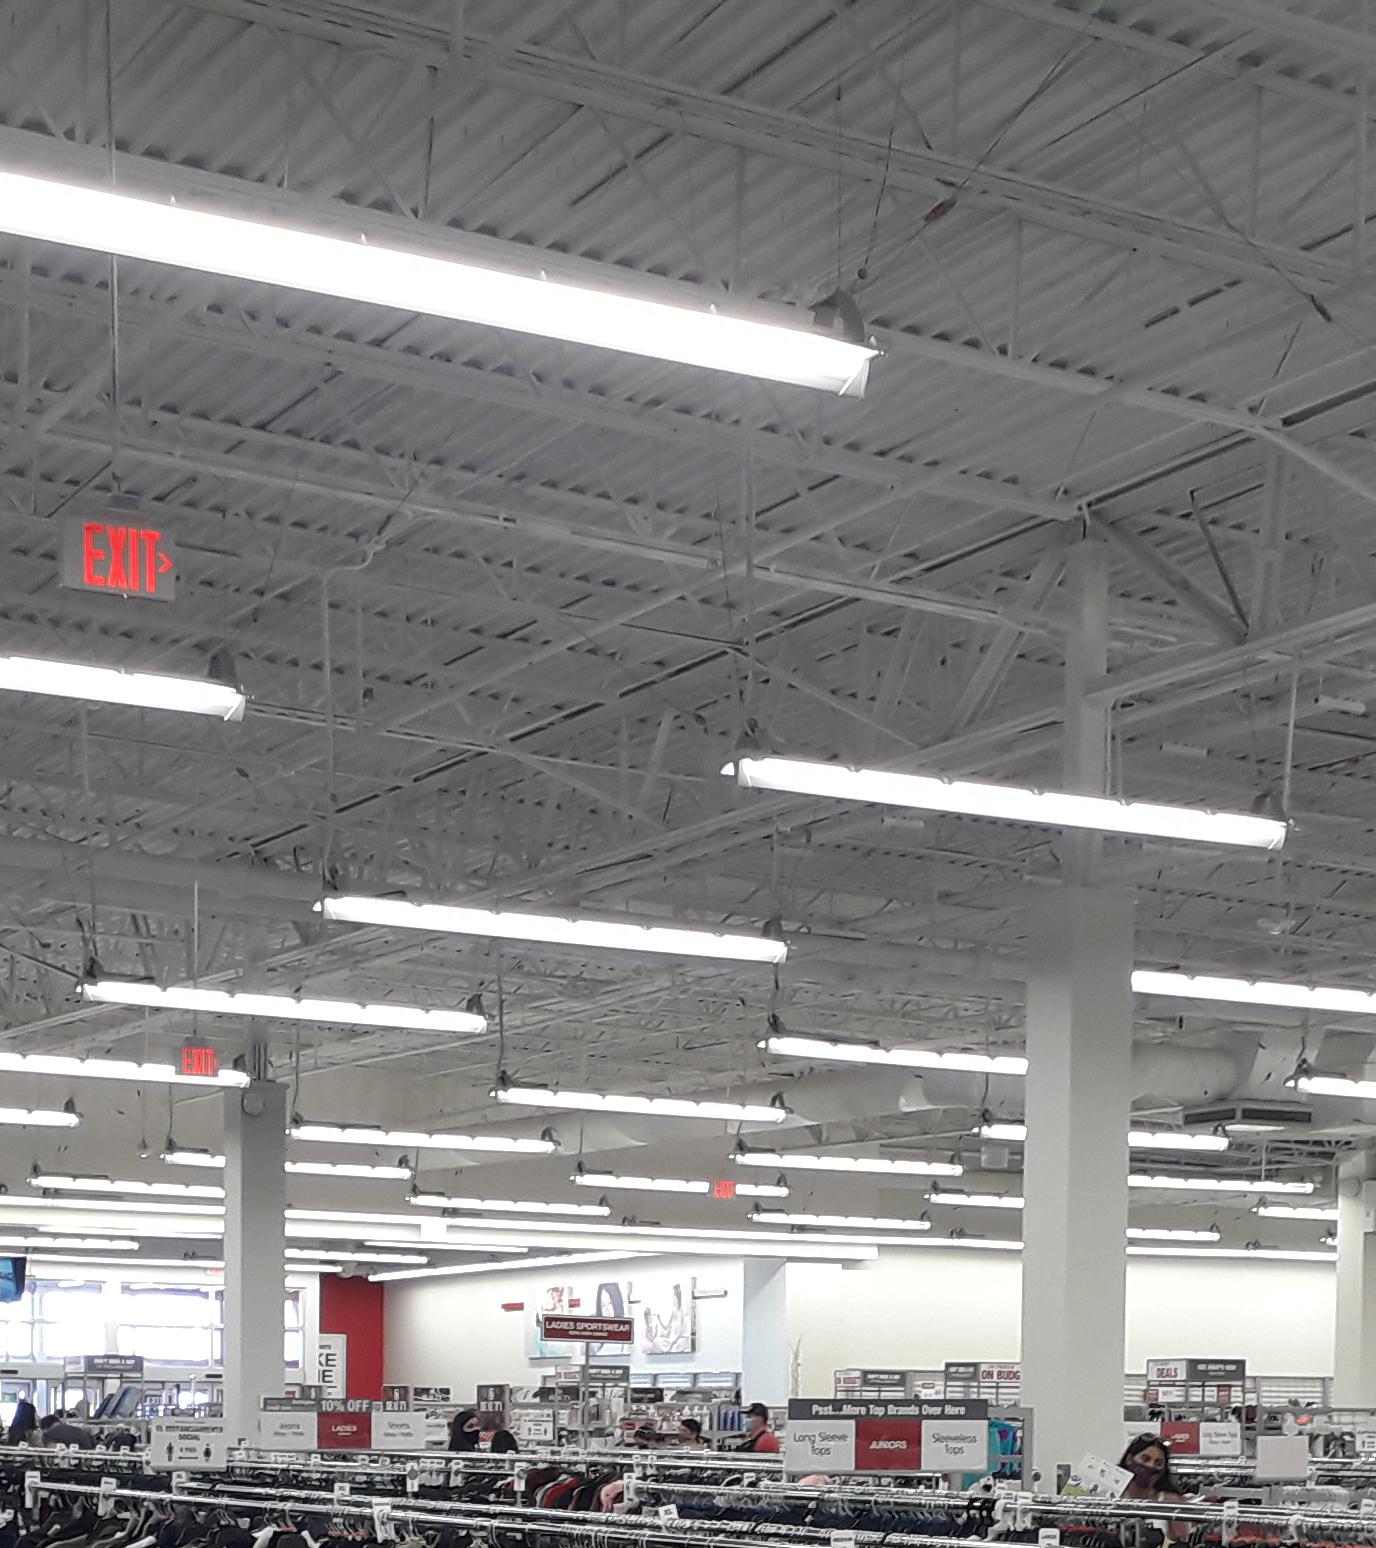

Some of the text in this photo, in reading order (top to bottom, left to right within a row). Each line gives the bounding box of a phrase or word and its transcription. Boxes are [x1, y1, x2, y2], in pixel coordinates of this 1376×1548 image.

[83, 521, 162, 594] EXIT
[996, 1371, 1021, 1381] BUDG
[321, 1400, 372, 1412] 10% OFF
[793, 1432, 848, 1444] Long Sleeve
[932, 1433, 978, 1443] Sleeveless
[869, 1440, 908, 1450] JUNIORS
